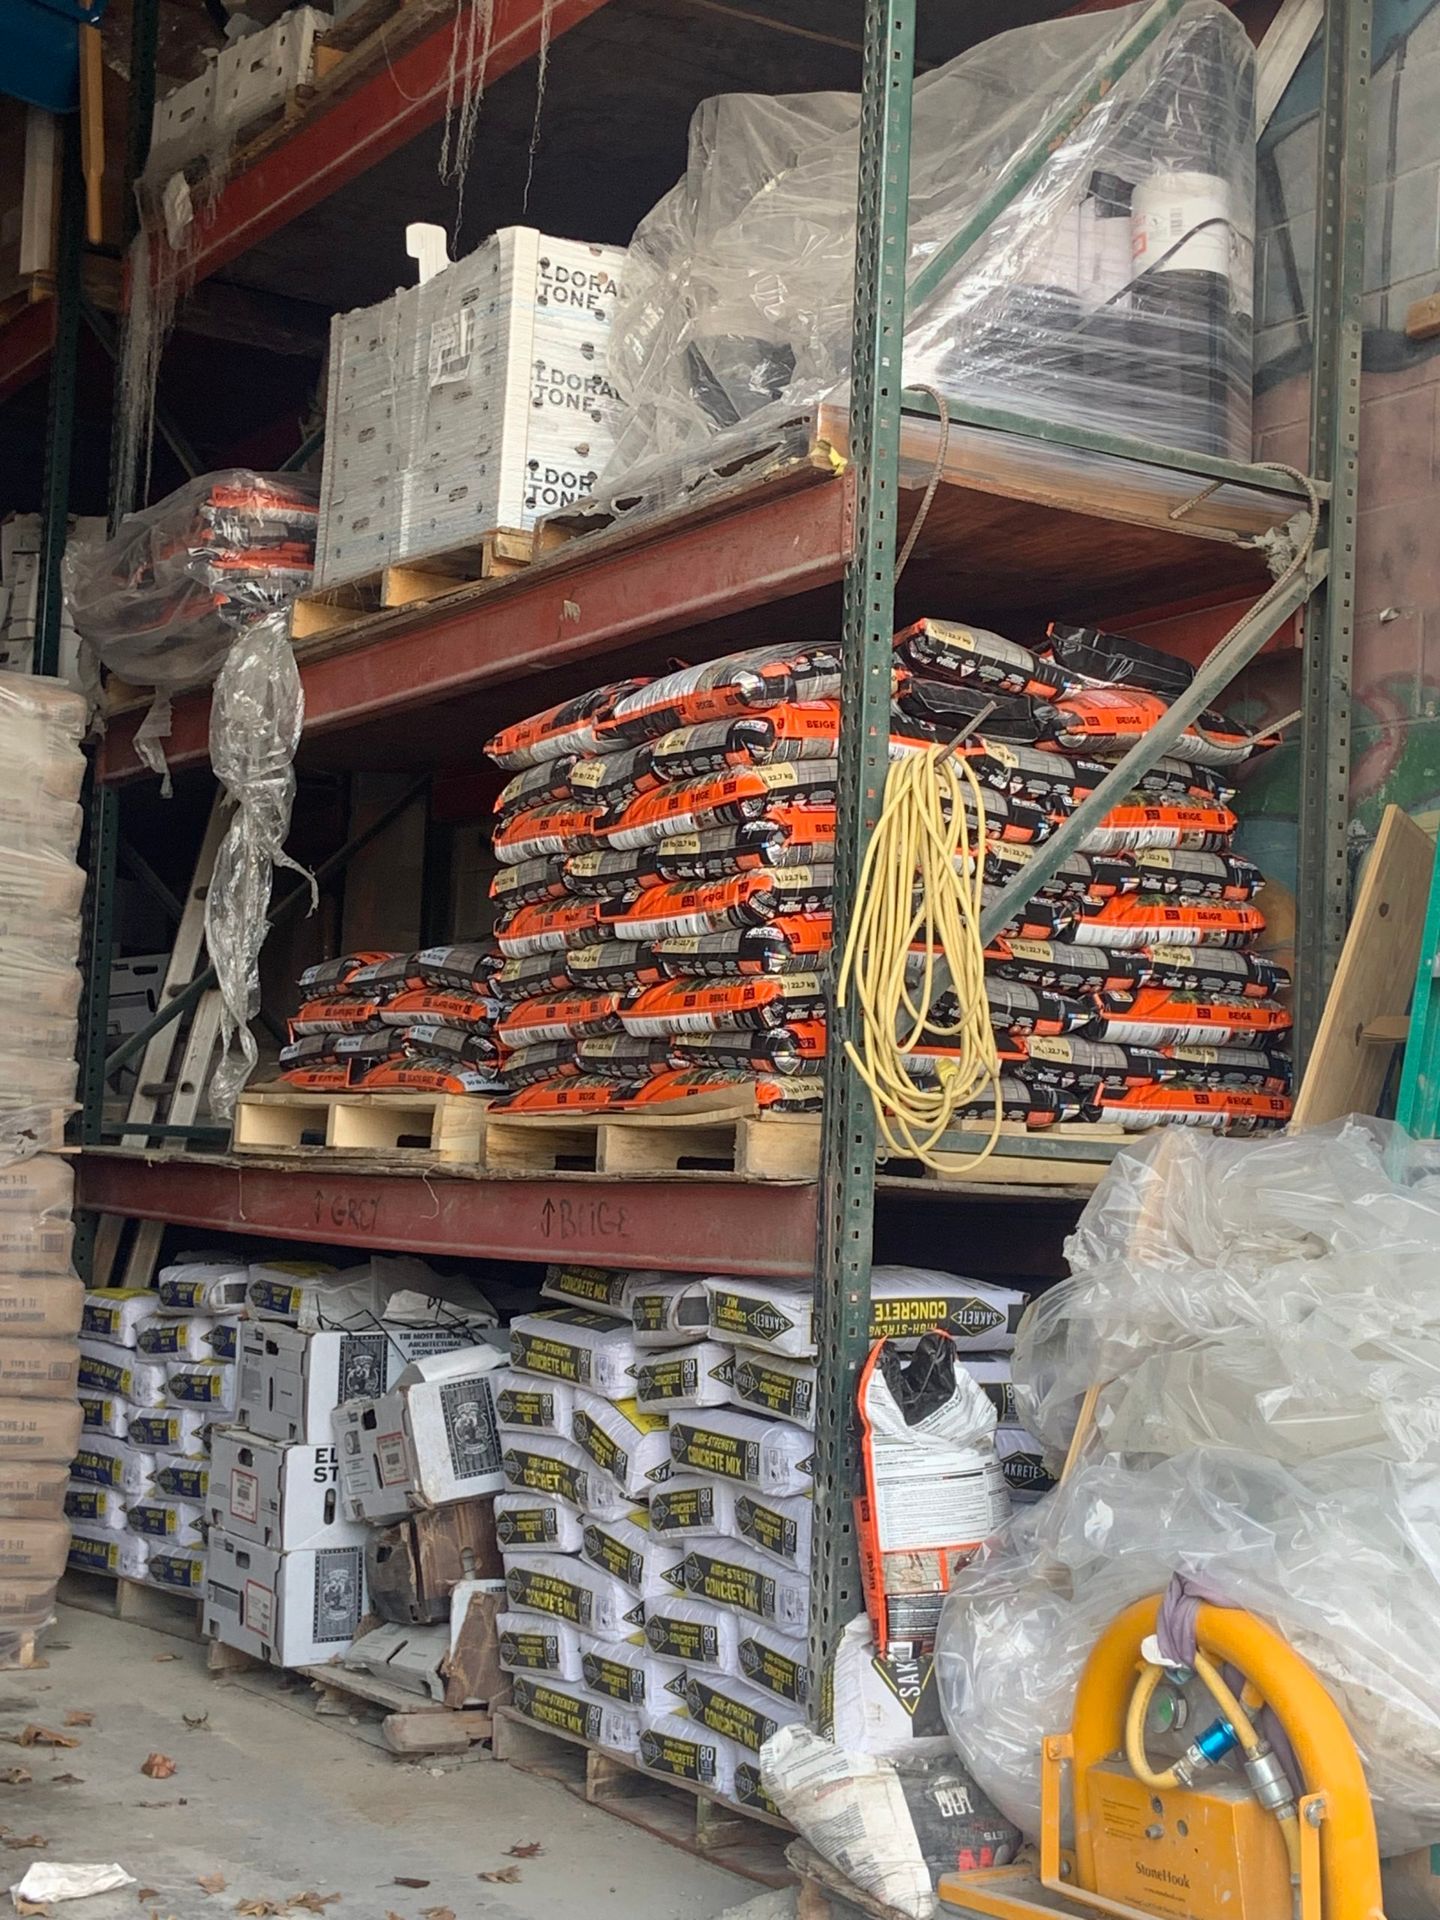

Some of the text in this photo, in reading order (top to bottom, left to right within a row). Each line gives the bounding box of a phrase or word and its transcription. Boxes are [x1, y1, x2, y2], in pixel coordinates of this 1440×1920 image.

[536, 283, 600, 311] TONE
[531, 385, 595, 412] TONE
[806, 720, 836, 729] BEIGE
[1116, 716, 1141, 724] BEIGE
[768, 772, 793, 782] 22.7 kg
[1178, 812, 1202, 821] BEIGE
[1198, 912, 1222, 921] BEIGE
[874, 1301, 947, 1321] CONCRETE
[956, 1310, 1000, 1325] SAKRETE
[756, 1313, 785, 1329] SAKRETE
[684, 1360, 696, 1373] 80
[718, 1368, 736, 1380] SA
[796, 1381, 810, 1395] 80
[785, 1520, 795, 1534] 80
[704, 1626, 715, 1641] 80
[632, 1669, 642, 1684] 80
[897, 1660, 920, 1697] SAK
[700, 1746, 713, 1761] 80
[1136, 1861, 1191, 1889] StoneHook
